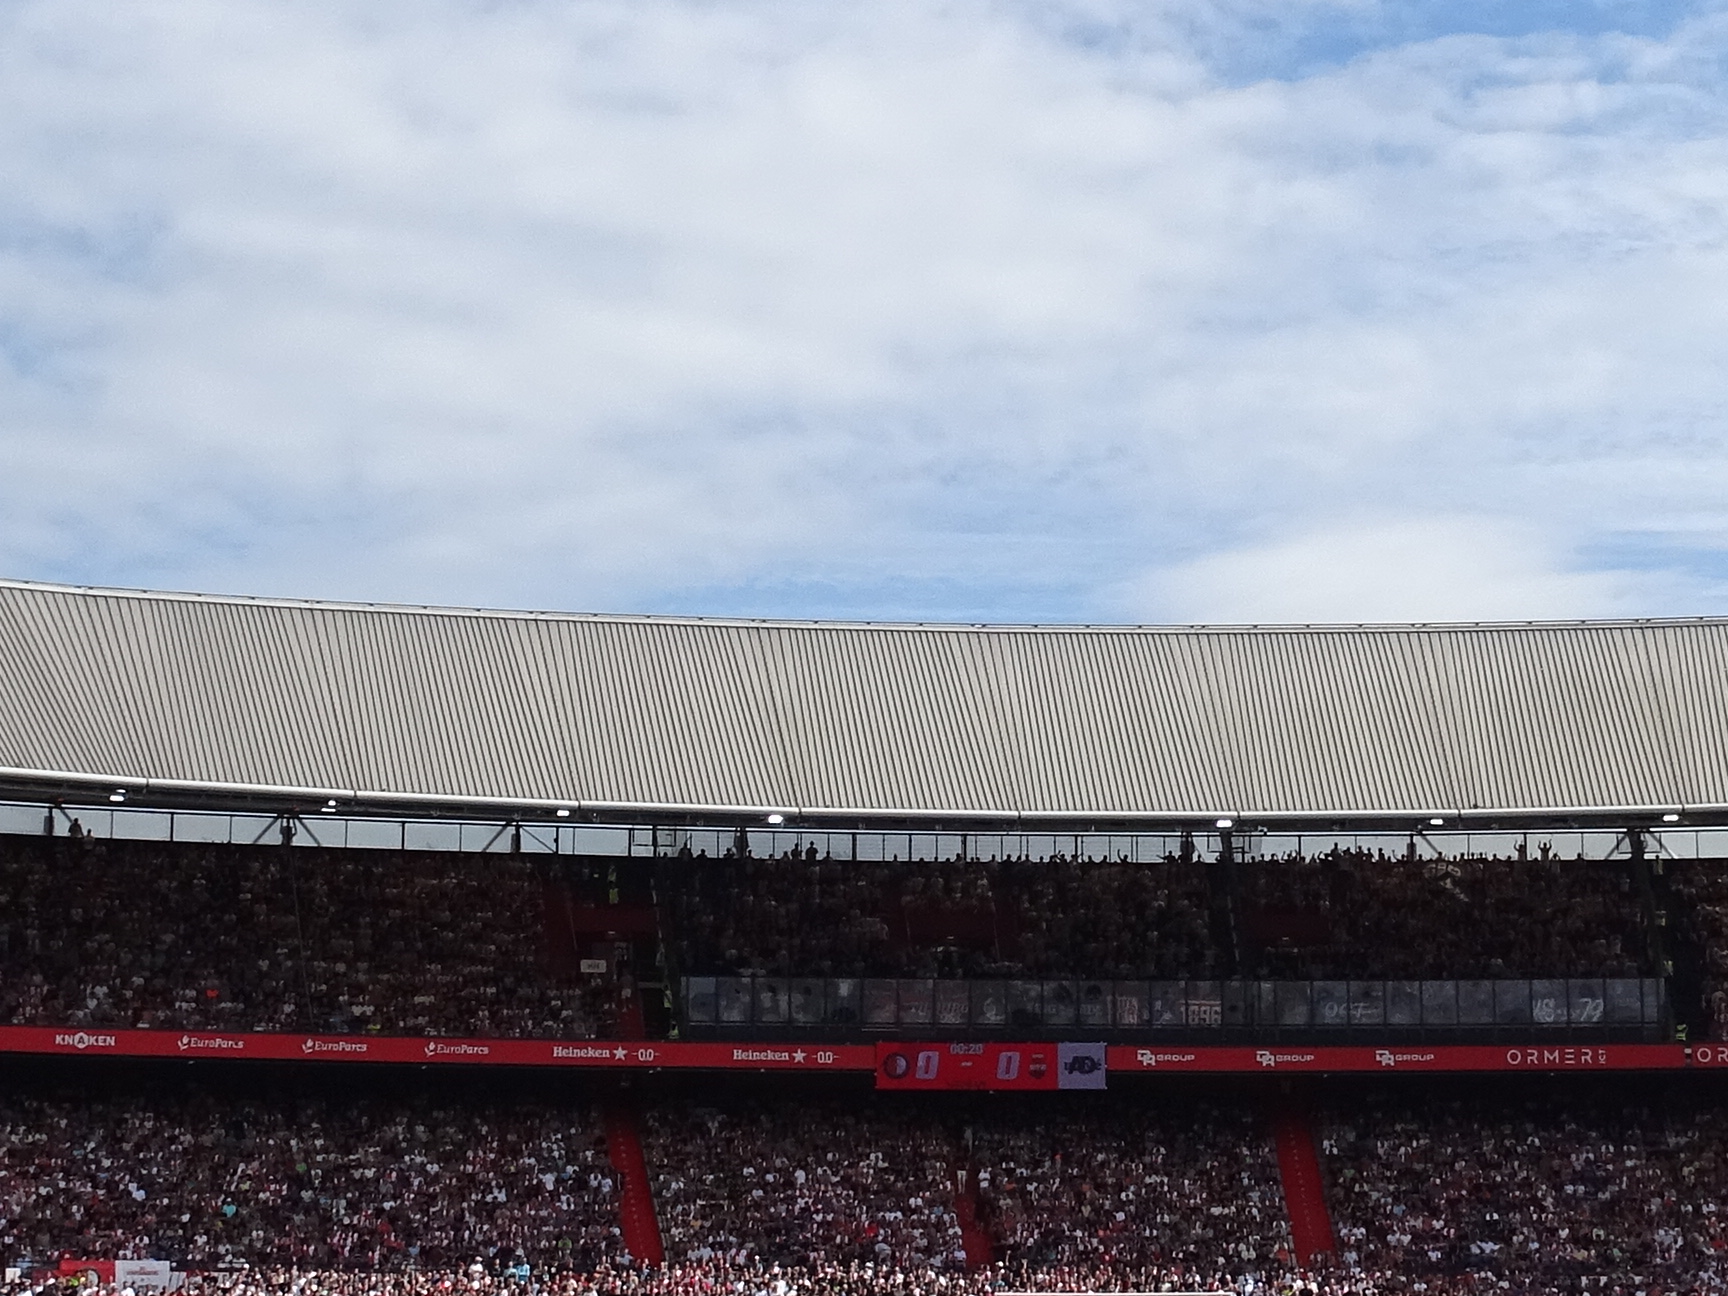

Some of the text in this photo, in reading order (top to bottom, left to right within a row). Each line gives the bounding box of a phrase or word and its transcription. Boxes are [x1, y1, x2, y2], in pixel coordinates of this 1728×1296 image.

[56, 1032, 115, 1049] KNAKEN
[314, 1041, 367, 1053] EuroParcs
[436, 1044, 489, 1055] EuroParcs
[553, 1046, 610, 1058] Heineken
[733, 1049, 789, 1061] Heineken
[1157, 1053, 1195, 1062] GROUP
[1276, 1054, 1314, 1063] GROUP
[1395, 1053, 1434, 1062] GROUP
[1507, 1048, 1593, 1065] ORMER
[915, 1051, 939, 1080] 0
[996, 1051, 1020, 1080] 0
